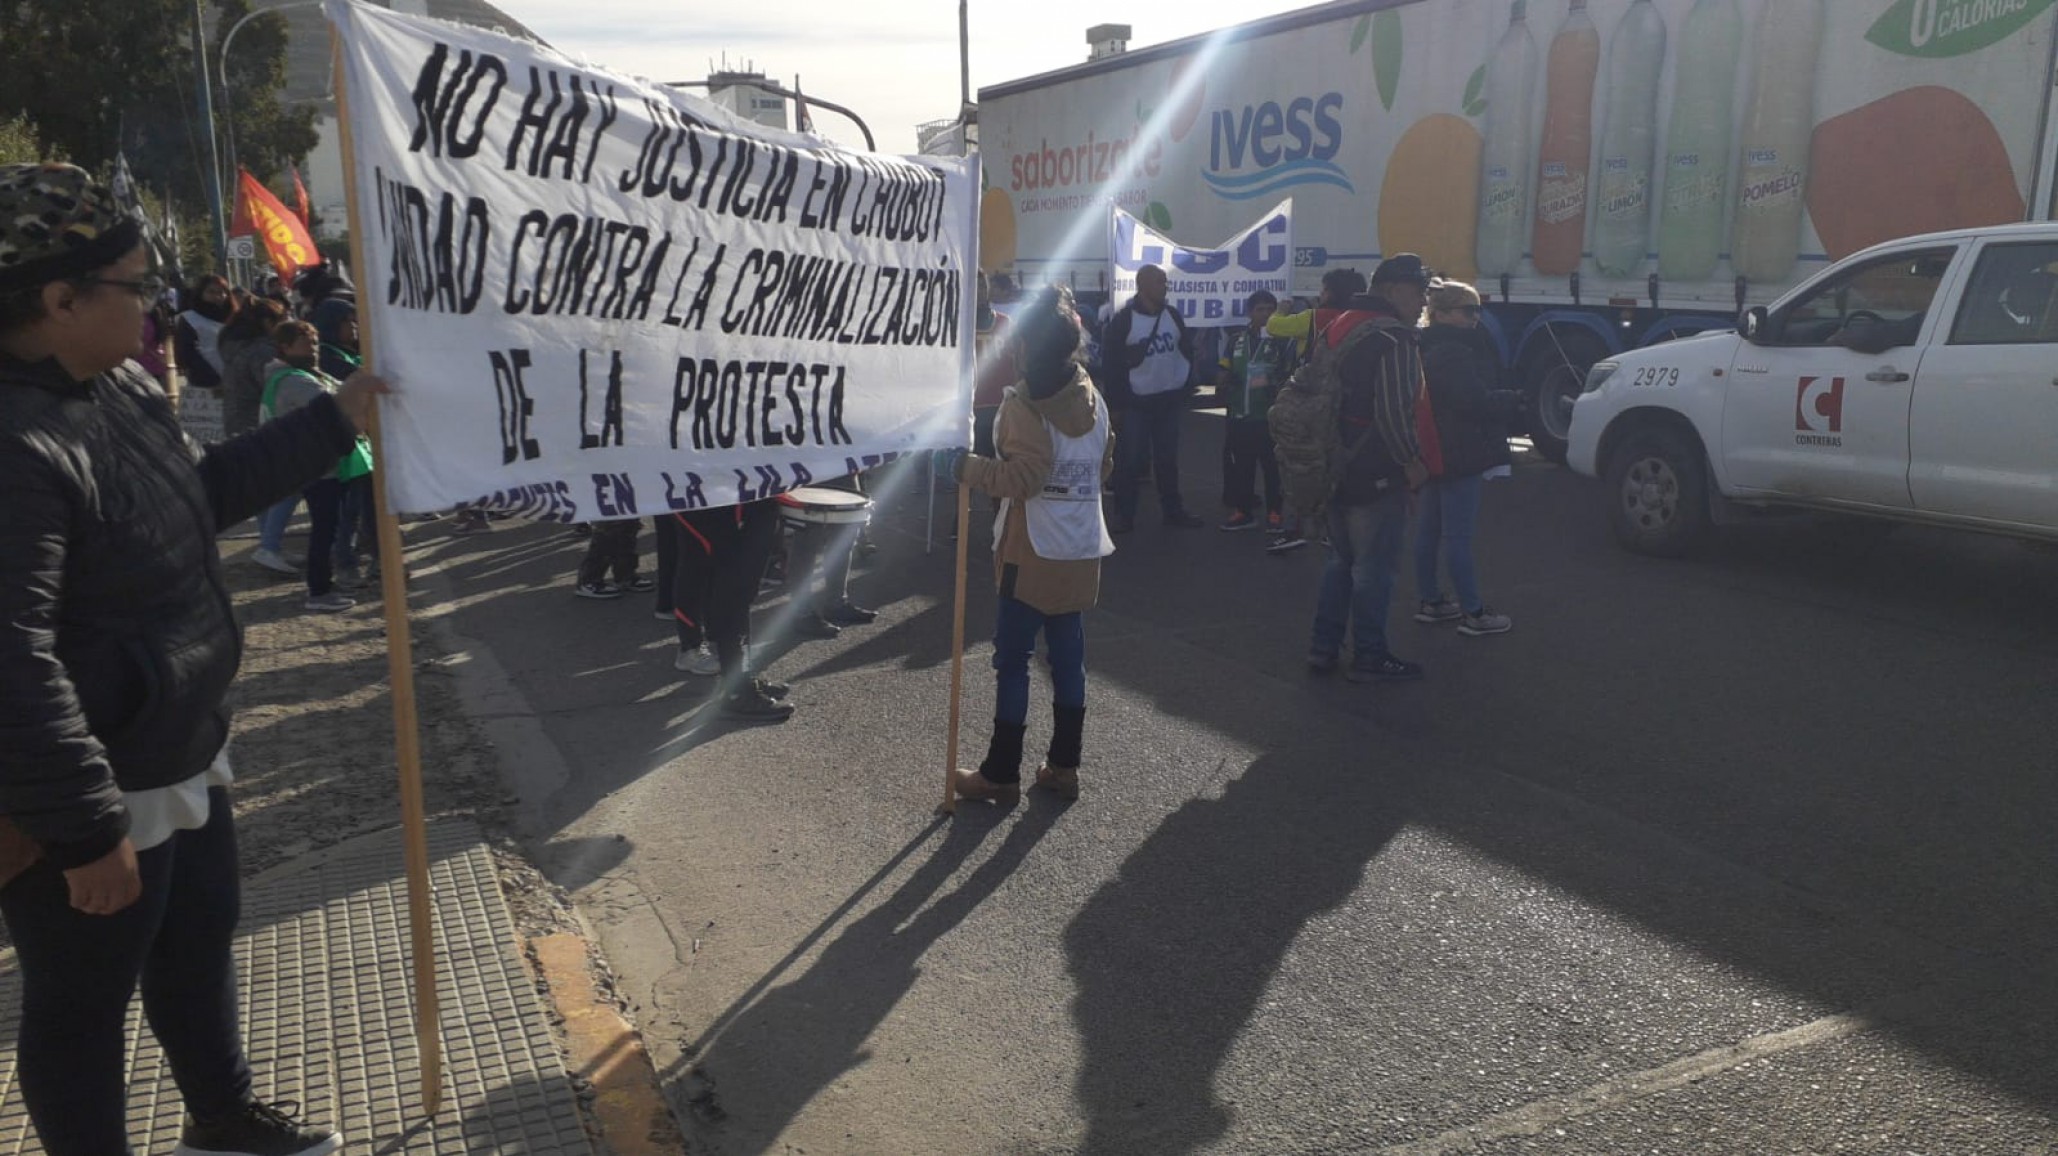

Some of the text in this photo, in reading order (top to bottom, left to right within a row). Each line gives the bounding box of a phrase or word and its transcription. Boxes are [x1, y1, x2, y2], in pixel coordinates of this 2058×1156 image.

[408, 42, 946, 243] NO HAY JUSTICIA EN CHUBUT
[1743, 172, 1800, 202] POMELO
[504, 210, 672, 320] CONTRA
[661, 237, 727, 331] LA
[720, 248, 960, 348] CRIMINALIZACIÓN
[1166, 279, 1218, 293] CLASISTA
[1222, 281, 1230, 293] Y
[1633, 367, 1680, 387] 2979
[489, 348, 852, 465] DE LA PROTESTA
[1796, 435, 1843, 448] CONTRERAS
[591, 472, 638, 517] EN
[660, 470, 708, 510] LA
